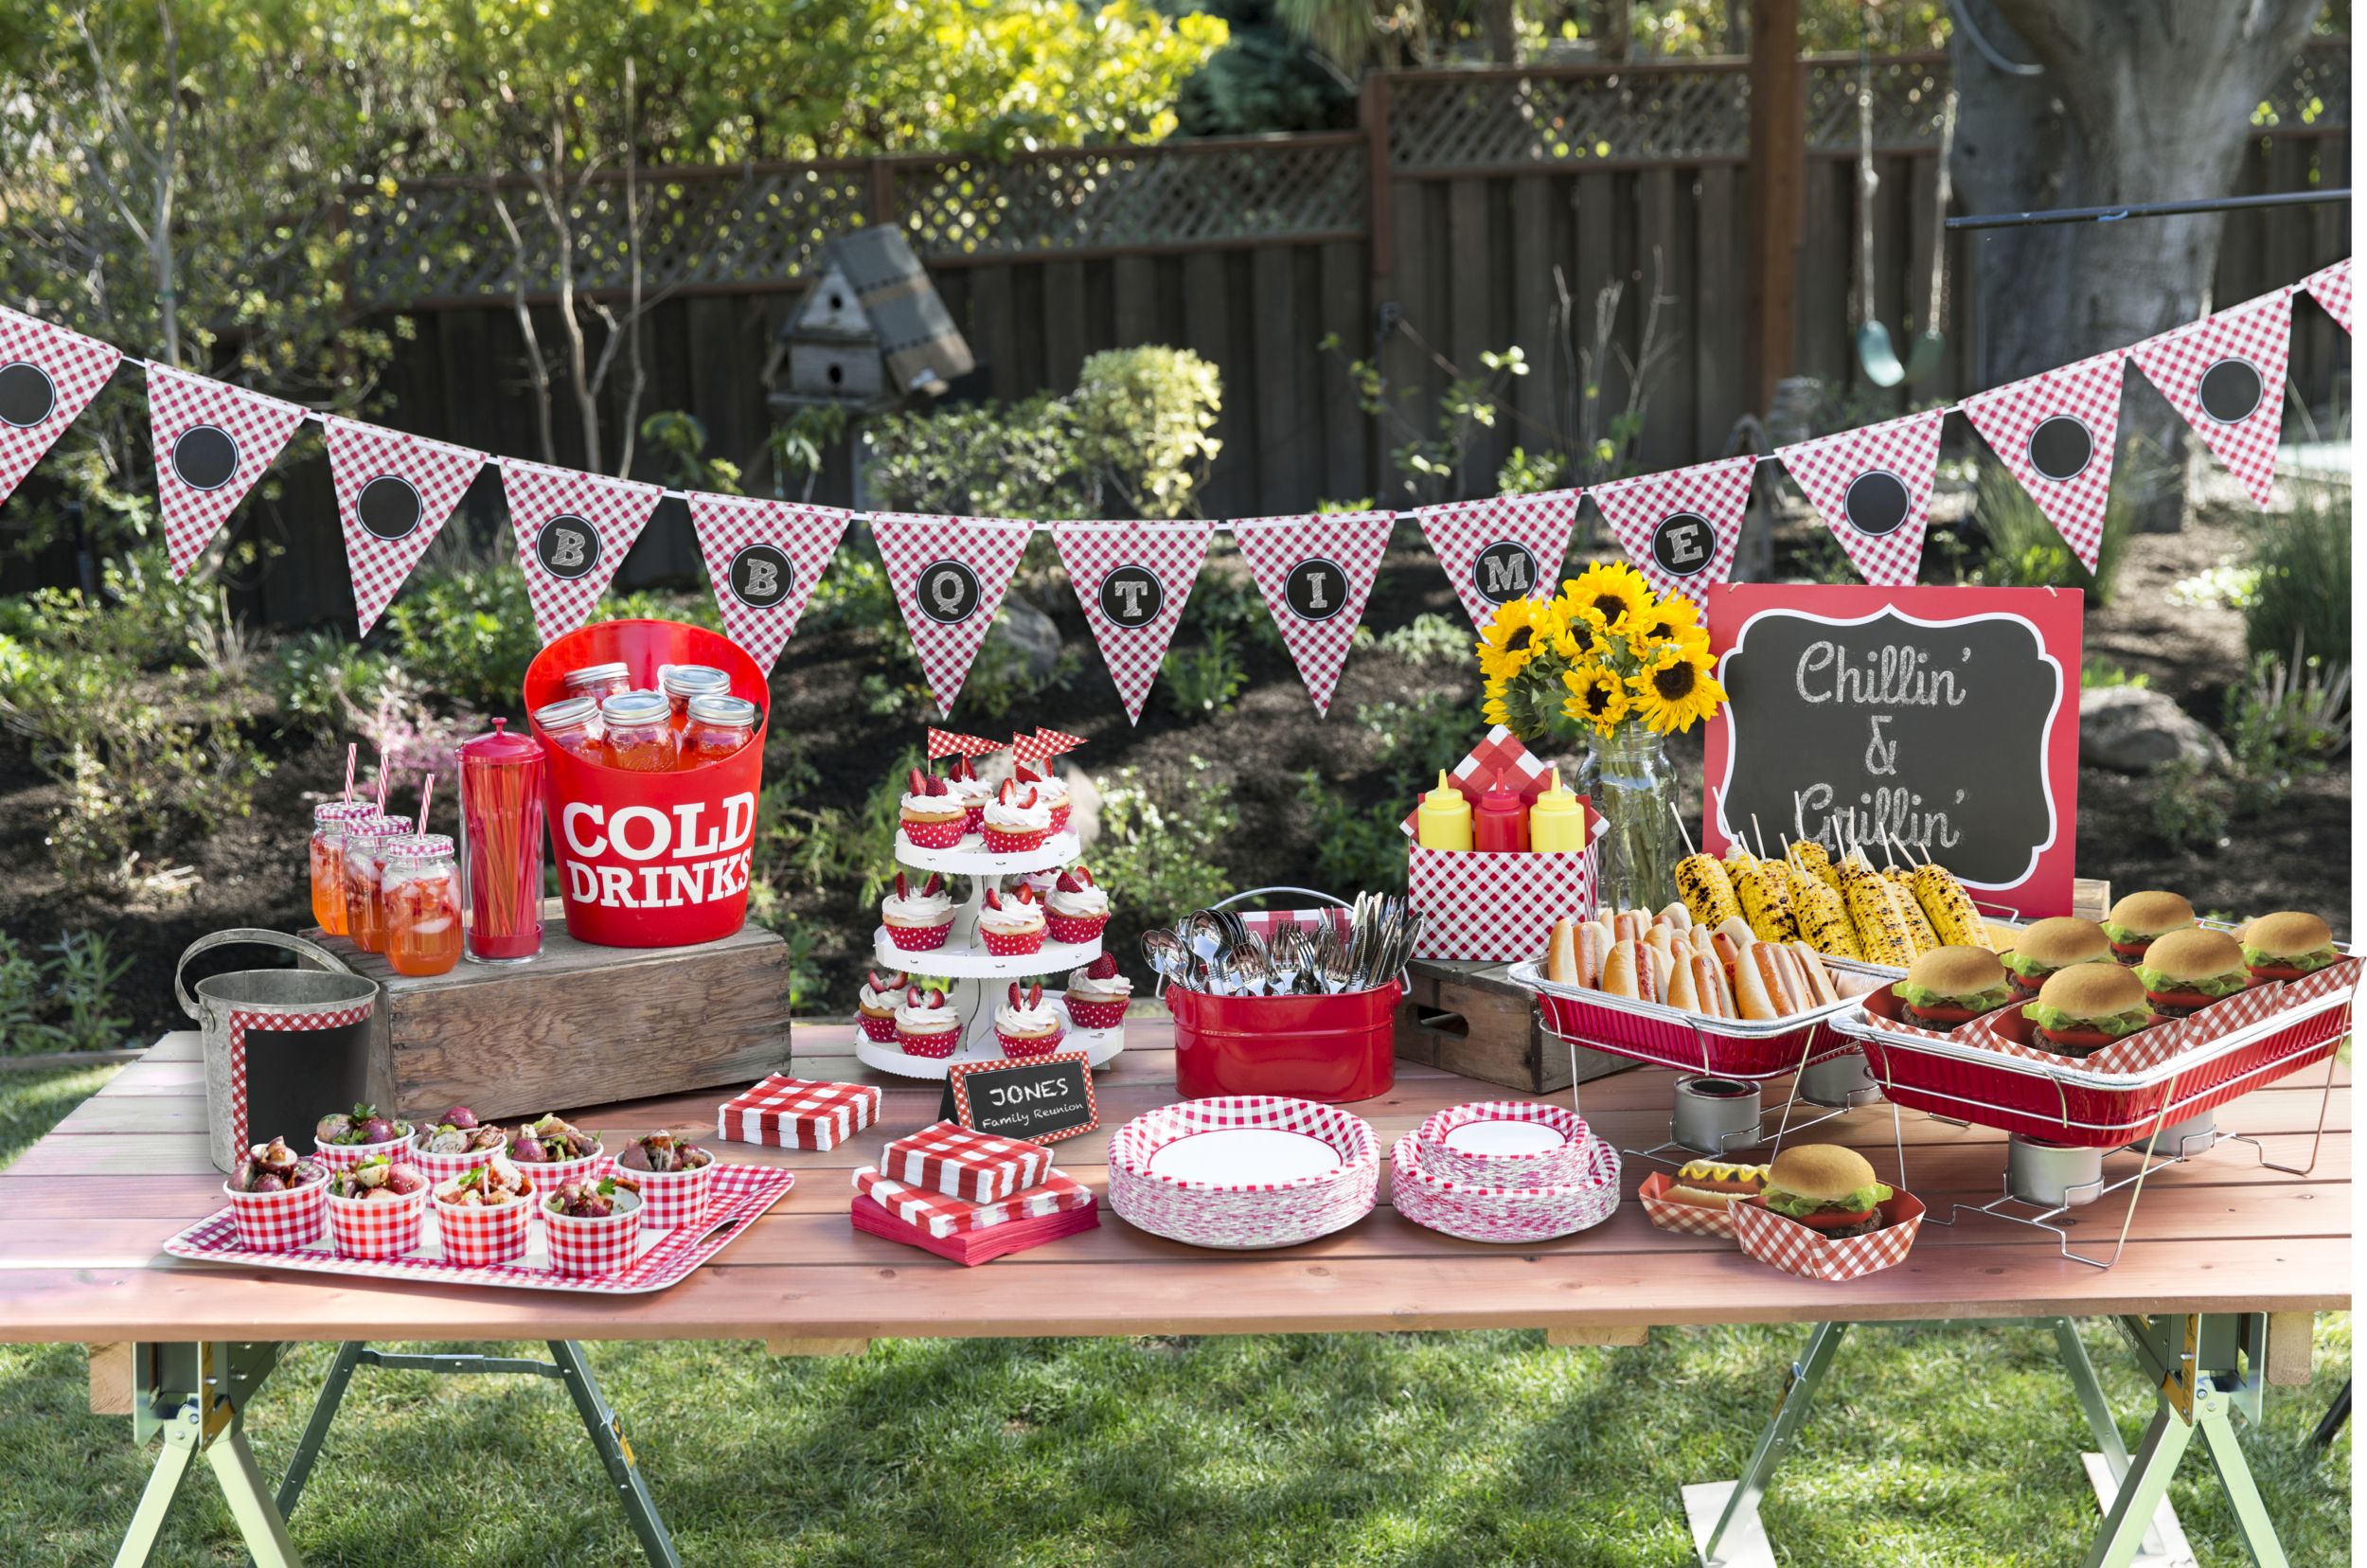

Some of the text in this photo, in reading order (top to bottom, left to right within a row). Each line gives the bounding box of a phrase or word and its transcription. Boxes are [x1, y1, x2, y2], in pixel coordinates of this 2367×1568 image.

[1796, 640, 1972, 706] Chillin'
[1865, 715, 1897, 775] &
[563, 791, 755, 861] COLD
[1794, 782, 1967, 852] Grillin'
[566, 846, 752, 909] DRINKS
[982, 1101, 1084, 1129] Family Reunion
[988, 1078, 1069, 1106] JONES
